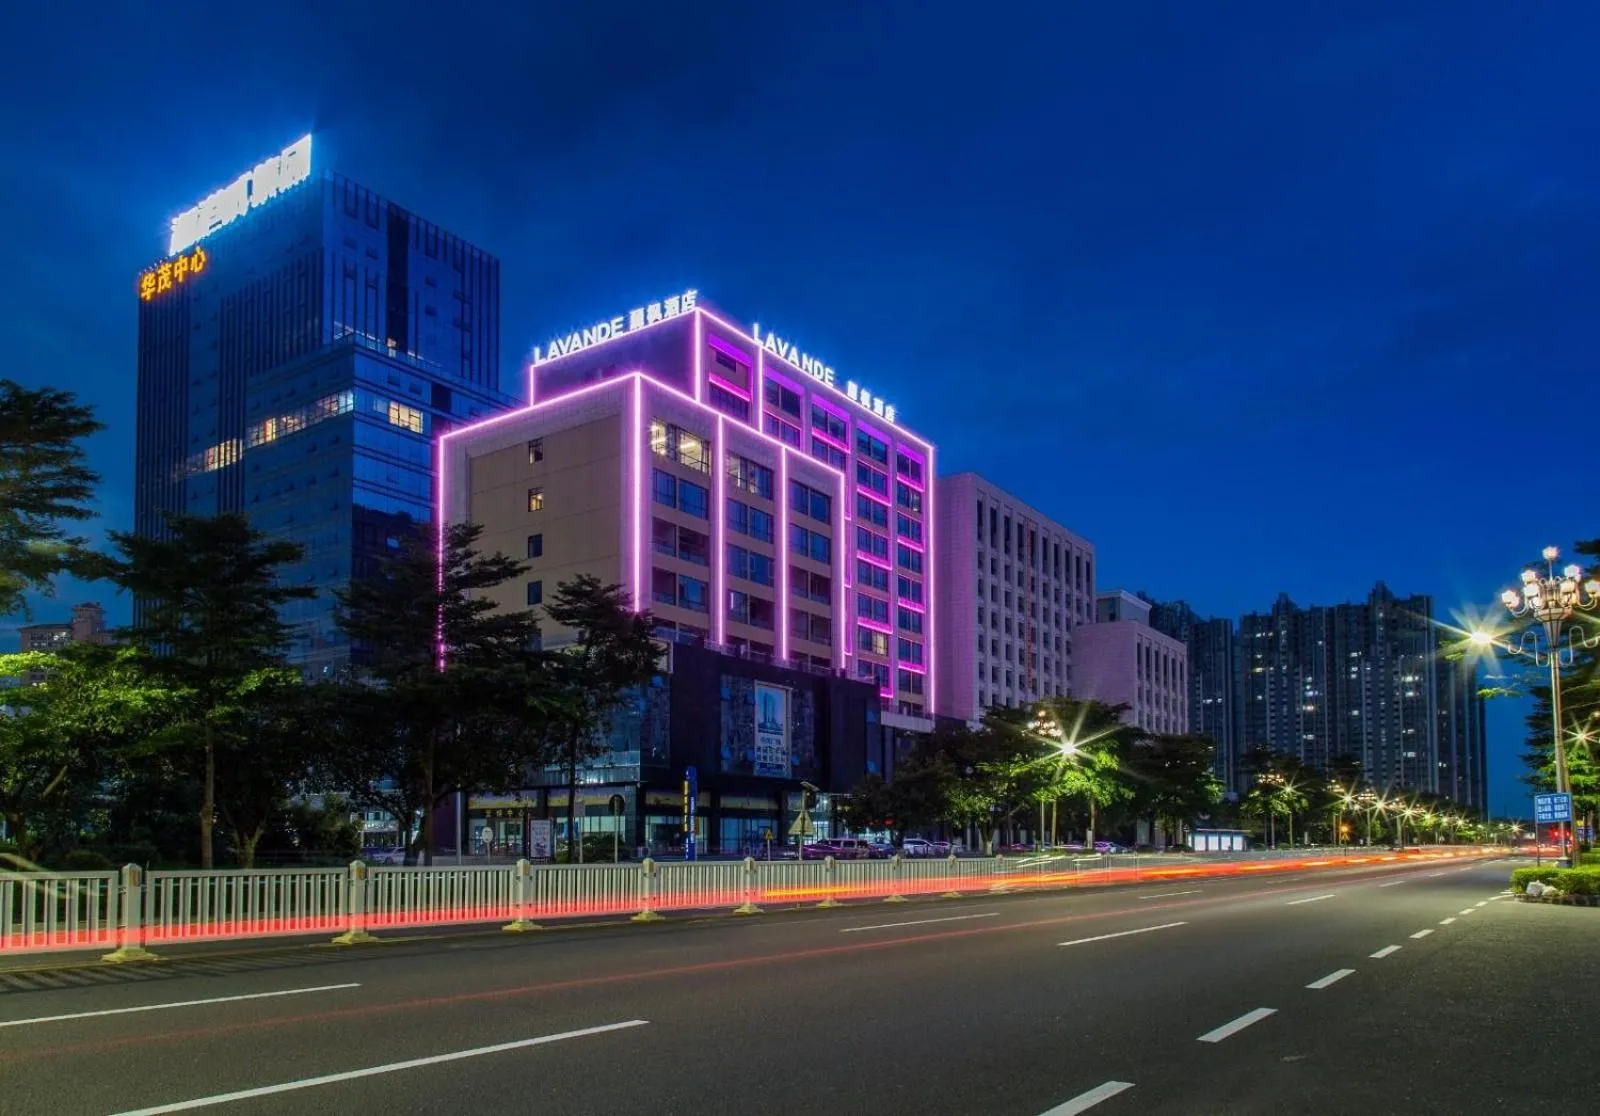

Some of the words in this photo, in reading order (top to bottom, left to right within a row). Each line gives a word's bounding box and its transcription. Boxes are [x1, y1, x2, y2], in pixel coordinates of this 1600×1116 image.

[139, 246, 206, 299] 华茂中心
[533, 316, 624, 366] LAVANDE
[753, 322, 835, 388] LAVANDE
